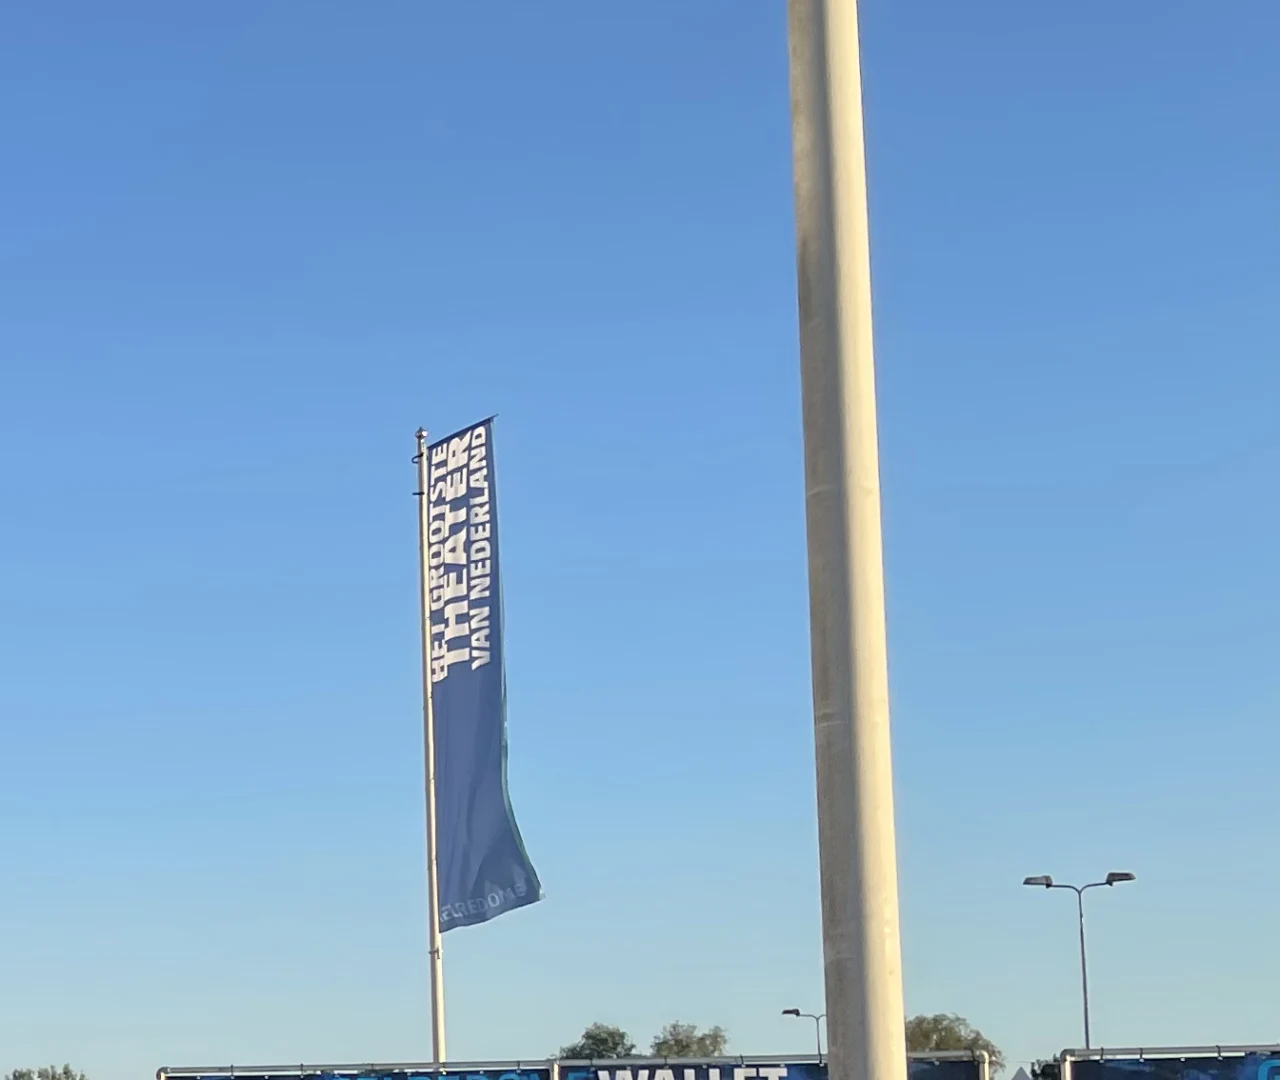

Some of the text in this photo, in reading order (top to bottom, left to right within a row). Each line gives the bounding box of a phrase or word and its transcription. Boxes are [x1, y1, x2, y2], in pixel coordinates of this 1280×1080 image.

[428, 446, 448, 612] GROOTSTE
[443, 429, 471, 667] THEATER
[468, 425, 491, 671] VAN NEDERLAND
